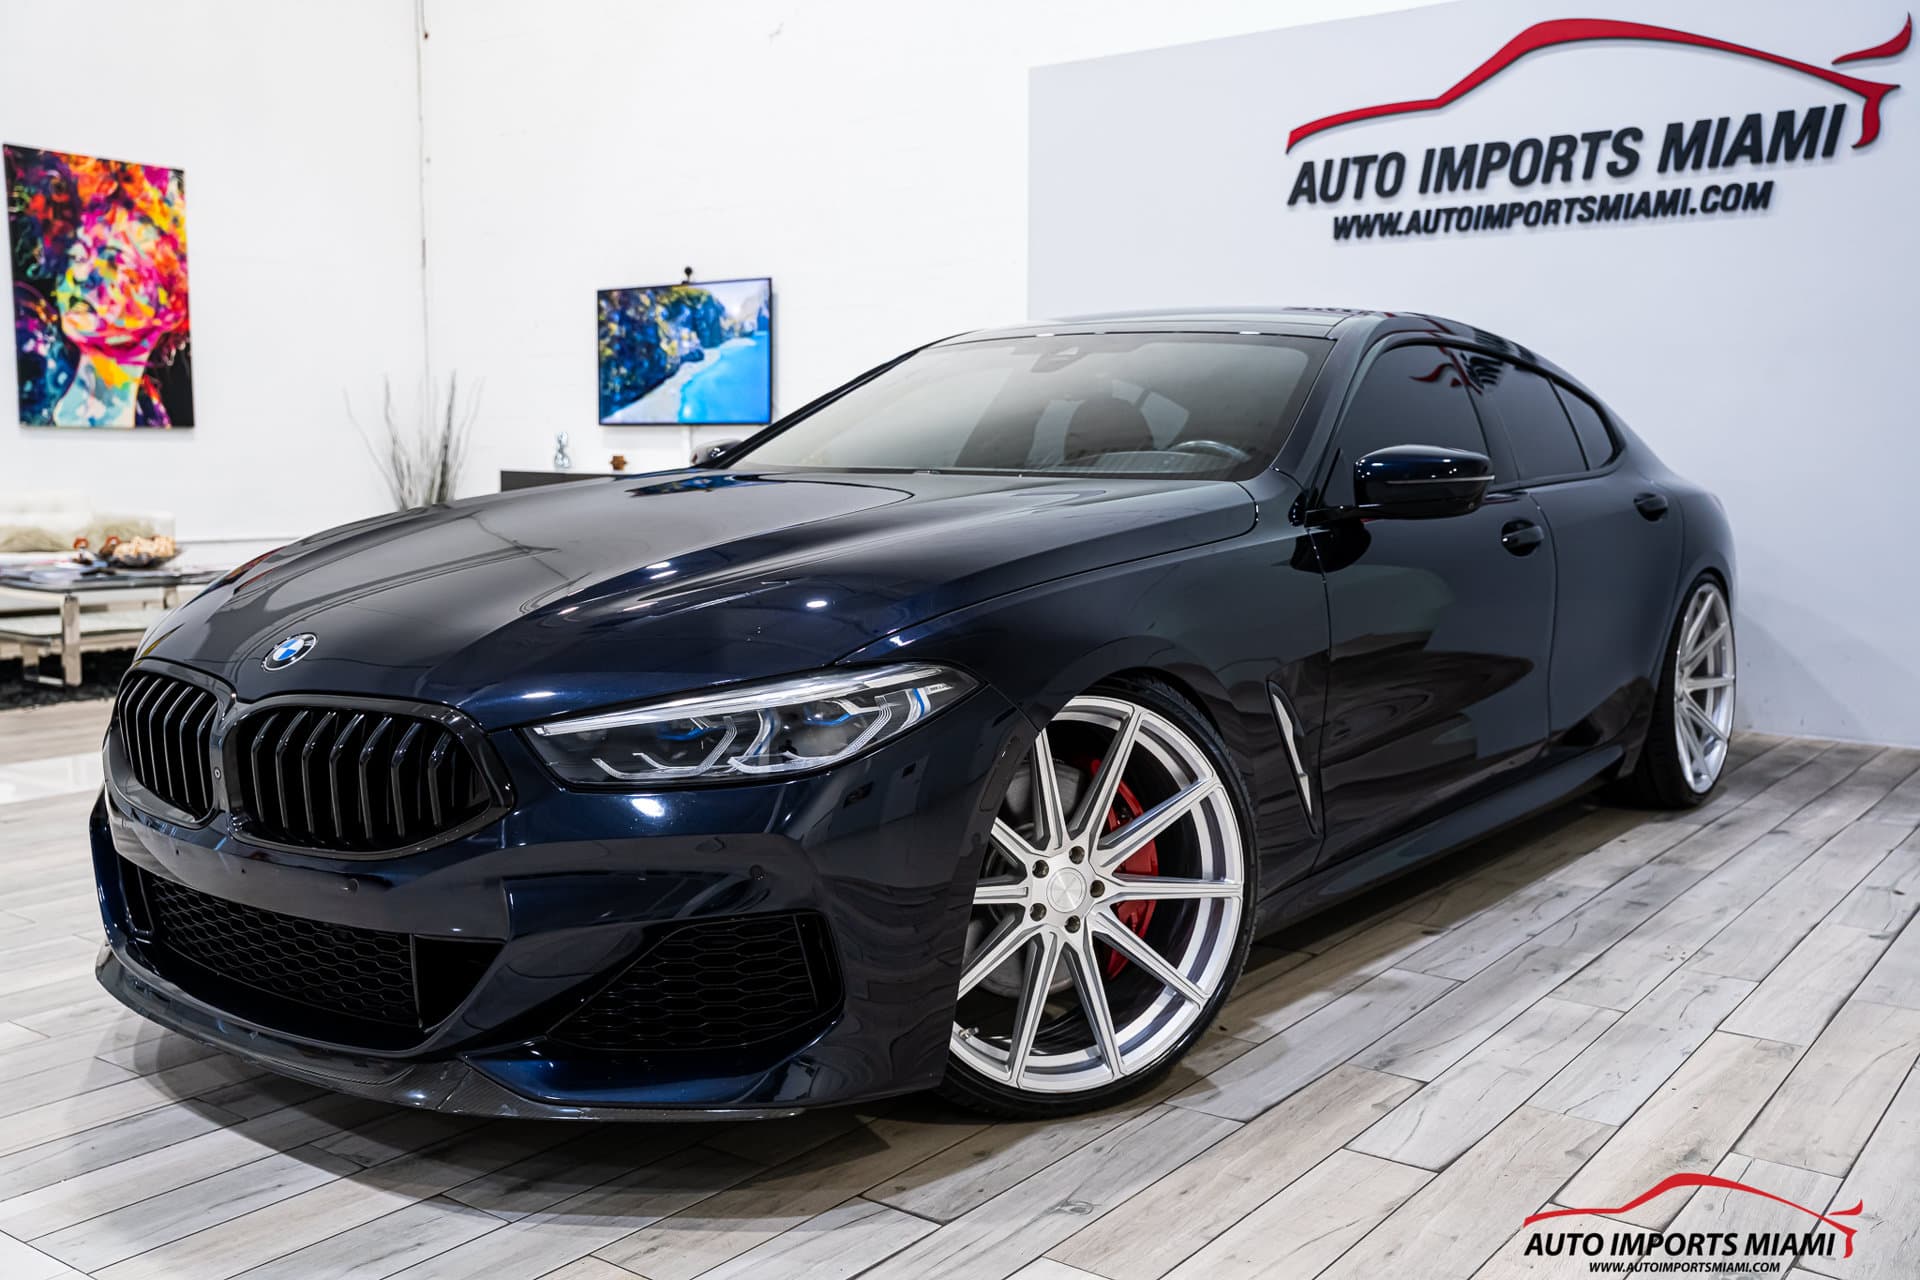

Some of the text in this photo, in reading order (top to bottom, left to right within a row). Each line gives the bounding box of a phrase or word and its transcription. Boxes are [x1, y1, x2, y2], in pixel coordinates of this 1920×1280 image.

[1287, 103, 1847, 206] AUTO IMPORTS MIAMI
[1333, 180, 1775, 240] WWW.AUTOIMPORTSMIAMI.COM
